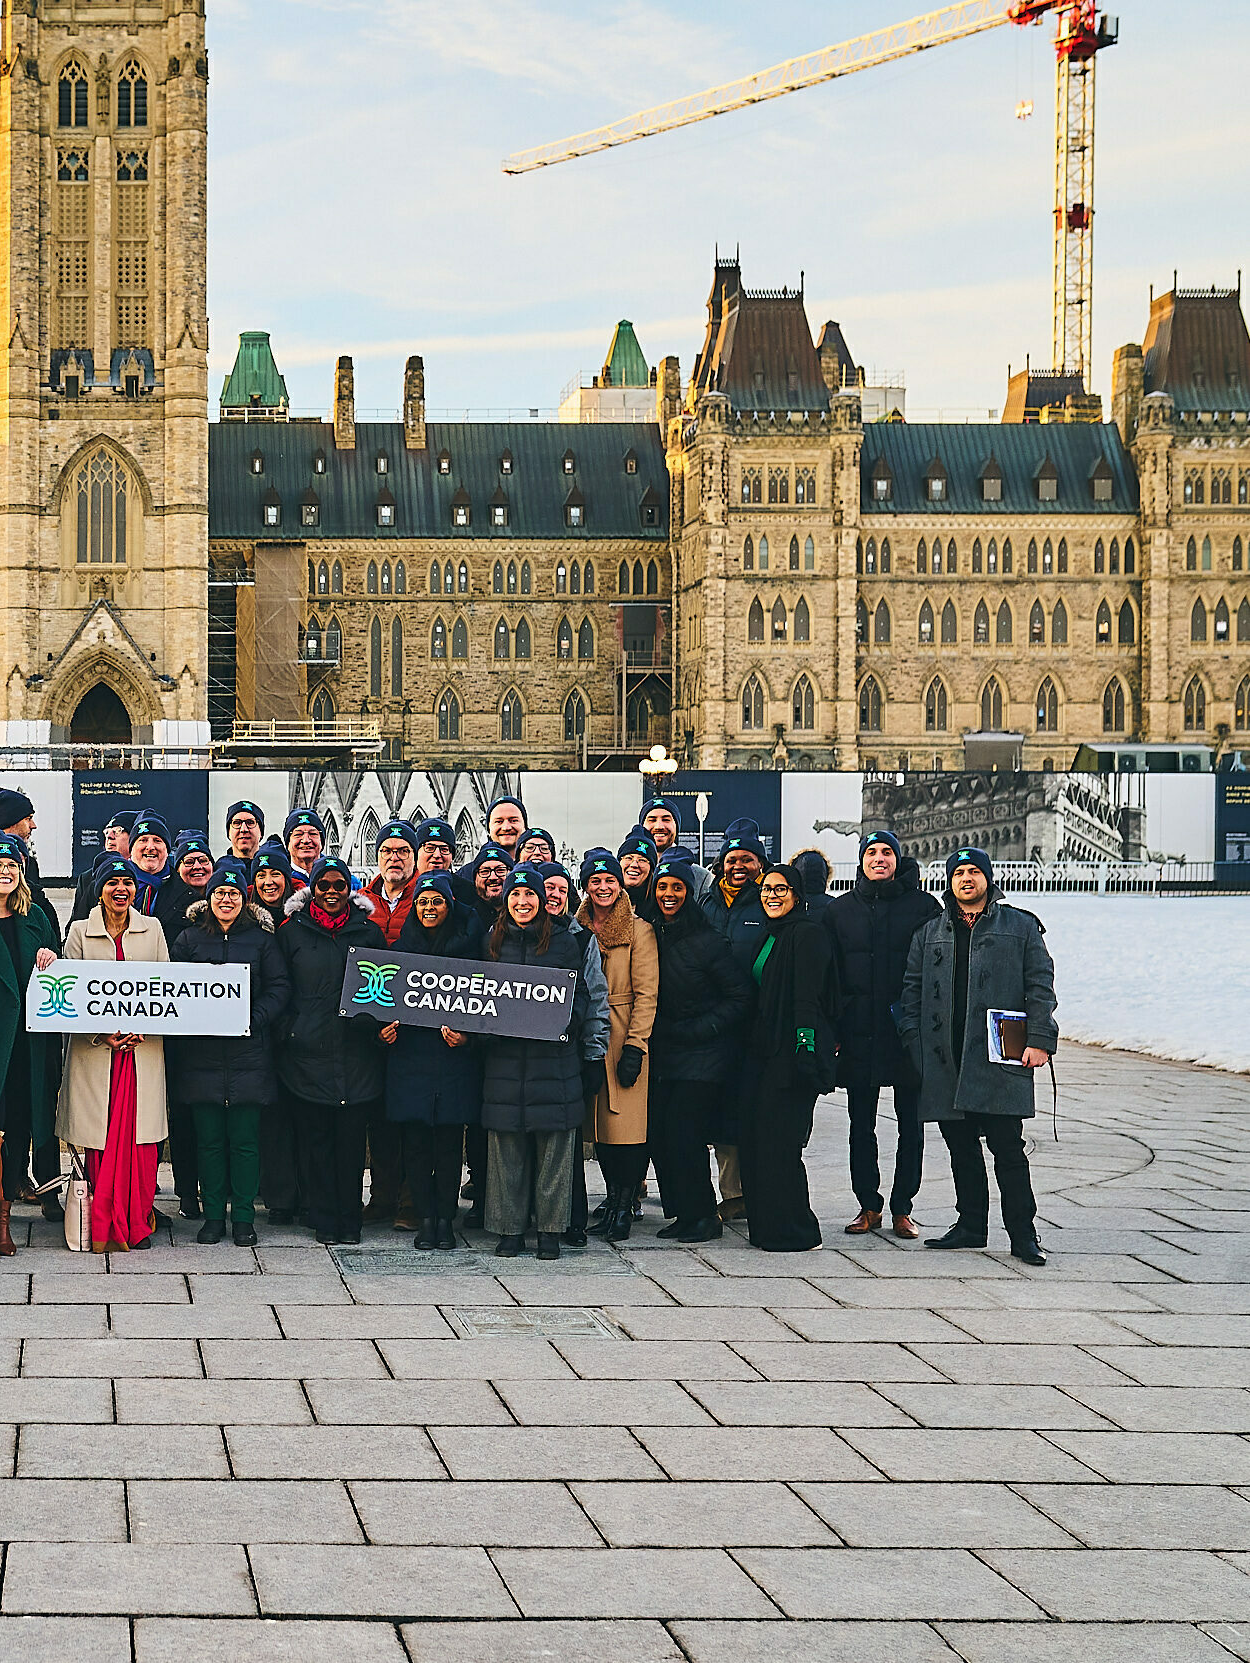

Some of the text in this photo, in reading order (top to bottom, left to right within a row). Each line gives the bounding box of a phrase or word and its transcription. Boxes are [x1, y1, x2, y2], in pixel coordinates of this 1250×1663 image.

[87, 976, 241, 998] COOPÉRATION
[406, 971, 567, 1004] COOPÉRATION
[87, 1000, 179, 1017] CANADA
[403, 991, 498, 1017] CANADA
